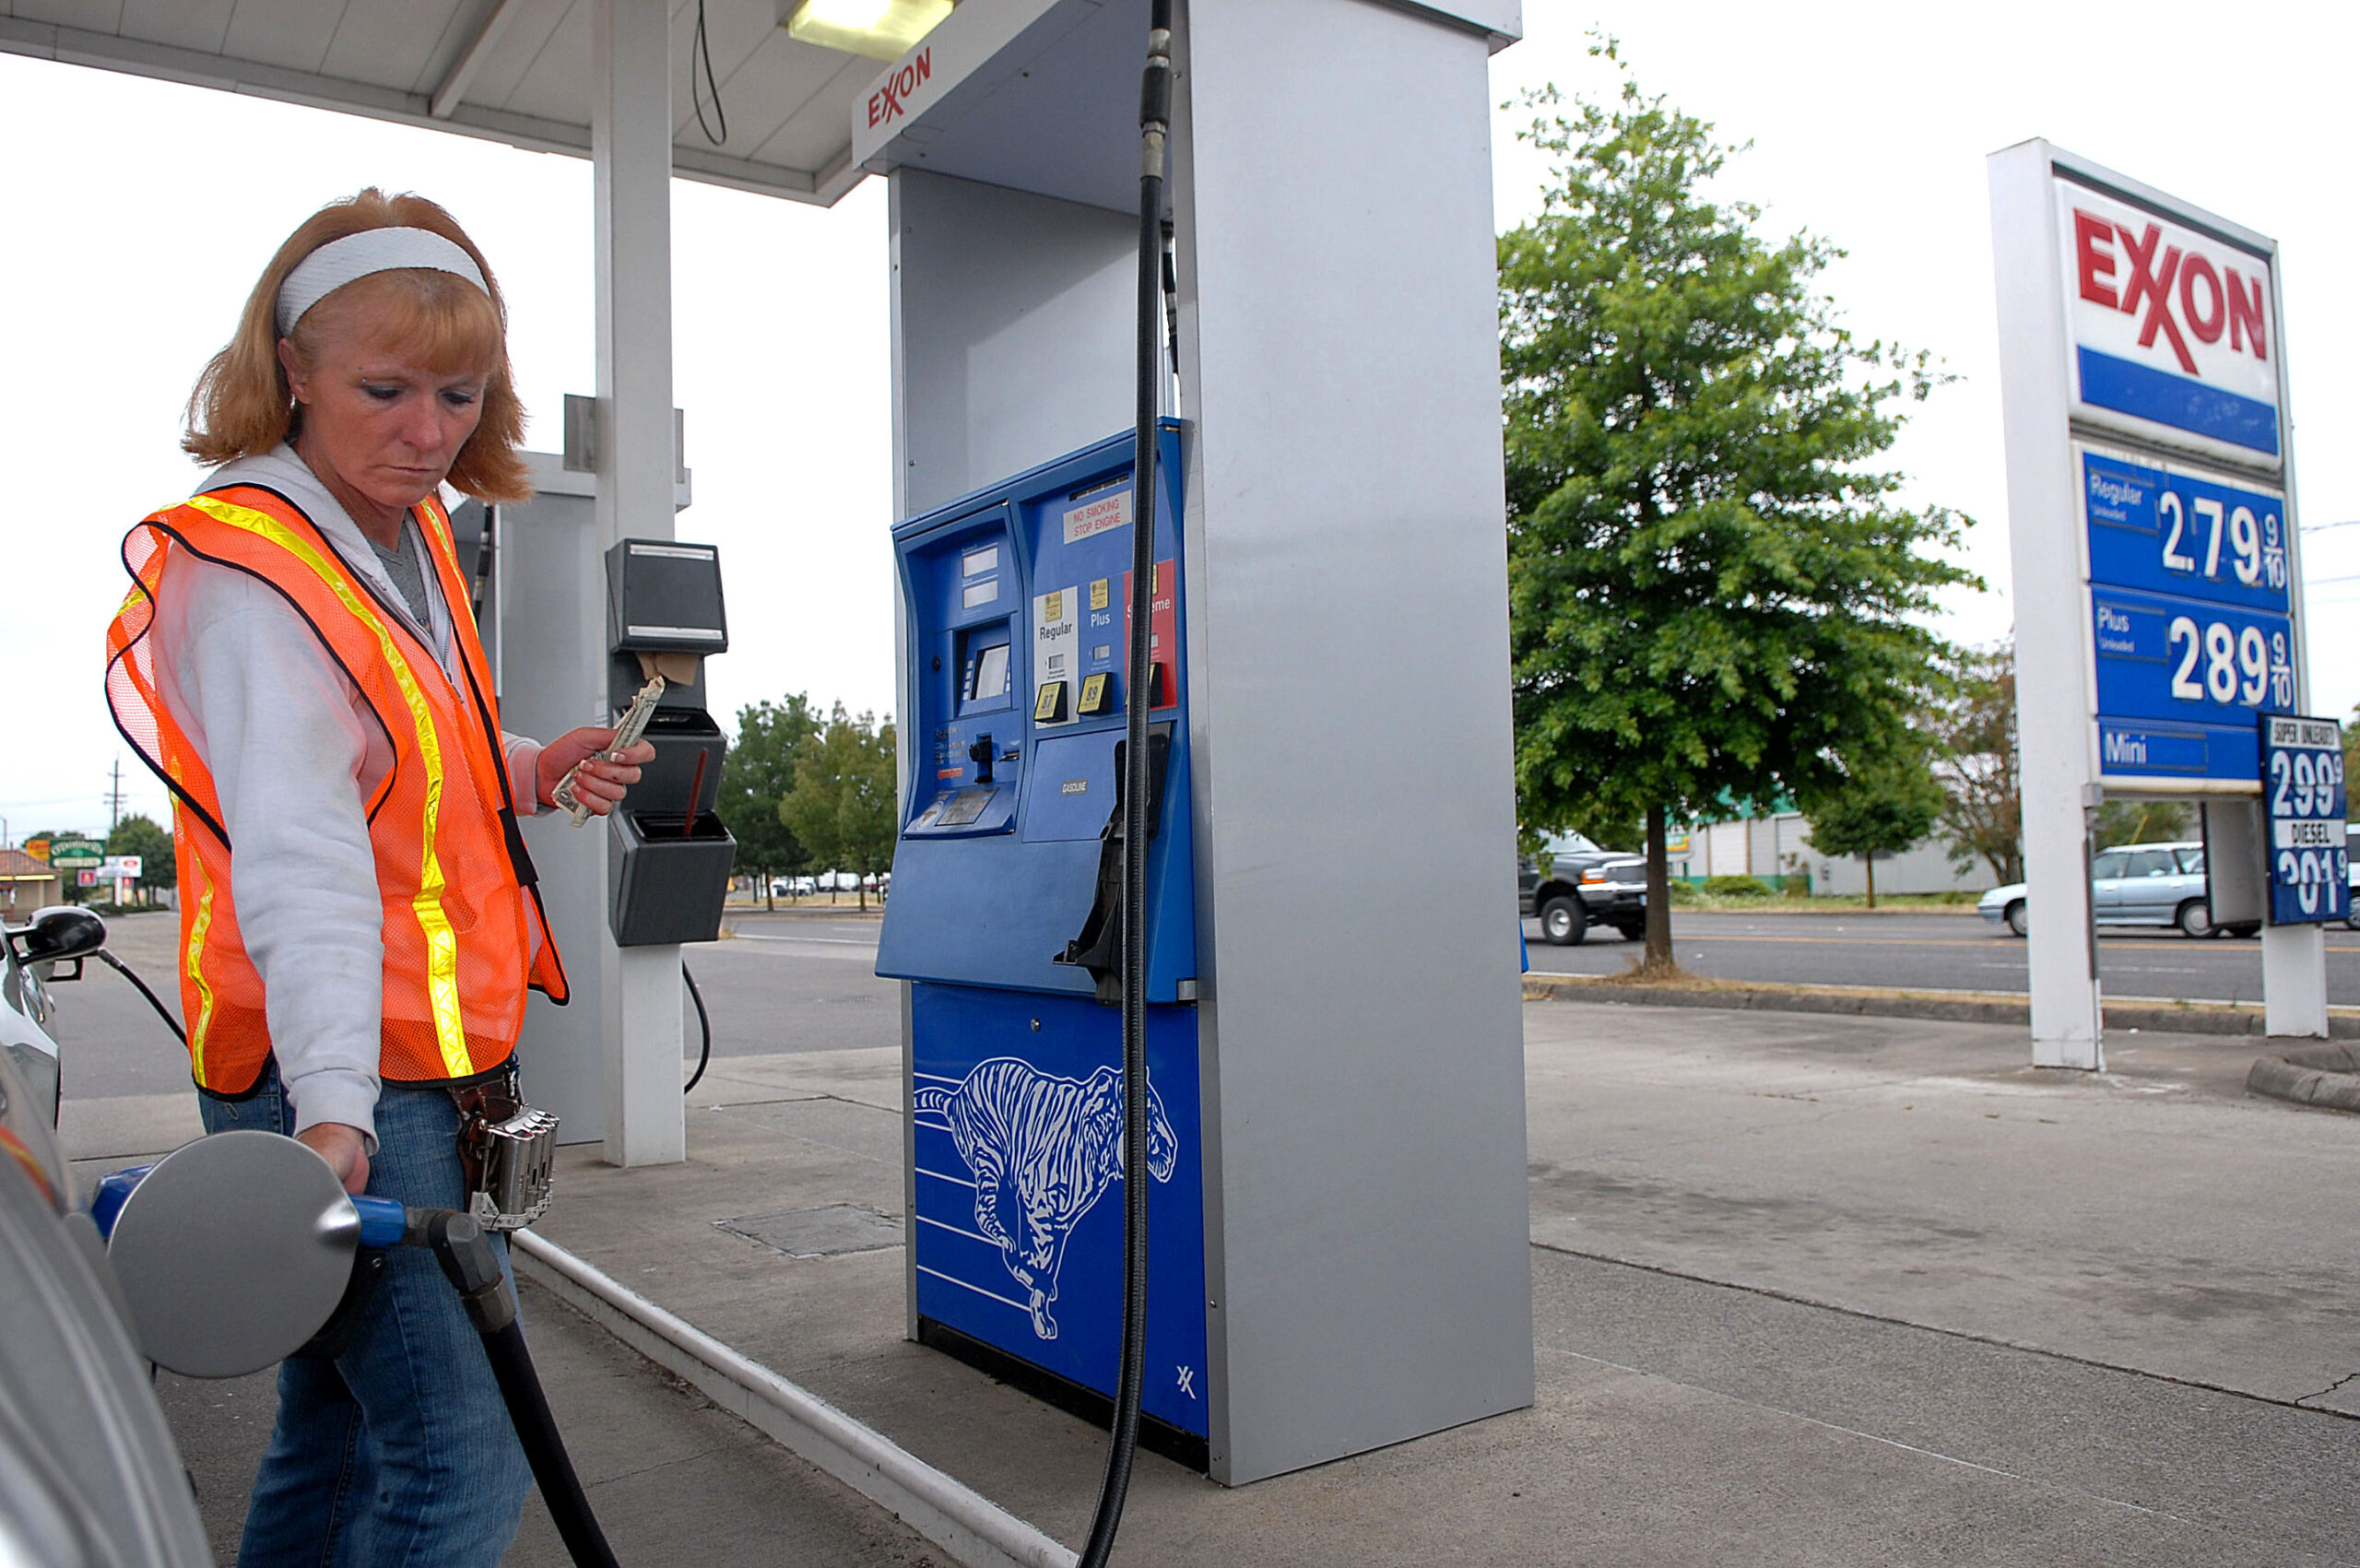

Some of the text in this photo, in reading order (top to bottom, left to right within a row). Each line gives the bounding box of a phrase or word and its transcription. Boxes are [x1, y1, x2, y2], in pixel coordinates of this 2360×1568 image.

[868, 46, 930, 129] EXXON
[2072, 207, 2267, 377] EXXON
[2090, 474, 2142, 506] Regular
[1073, 499, 1119, 524] NO SMOKING
[1074, 513, 1121, 536] STOP ENGINE
[1040, 621, 1073, 642] Regular
[1091, 612, 1111, 629] Plus
[2098, 607, 2130, 632] Plus
[1086, 686, 1099, 701] 89
[2274, 722, 2297, 743] SUPER
[2105, 732, 2147, 764] Mini
[2292, 823, 2331, 844] DIESEL
